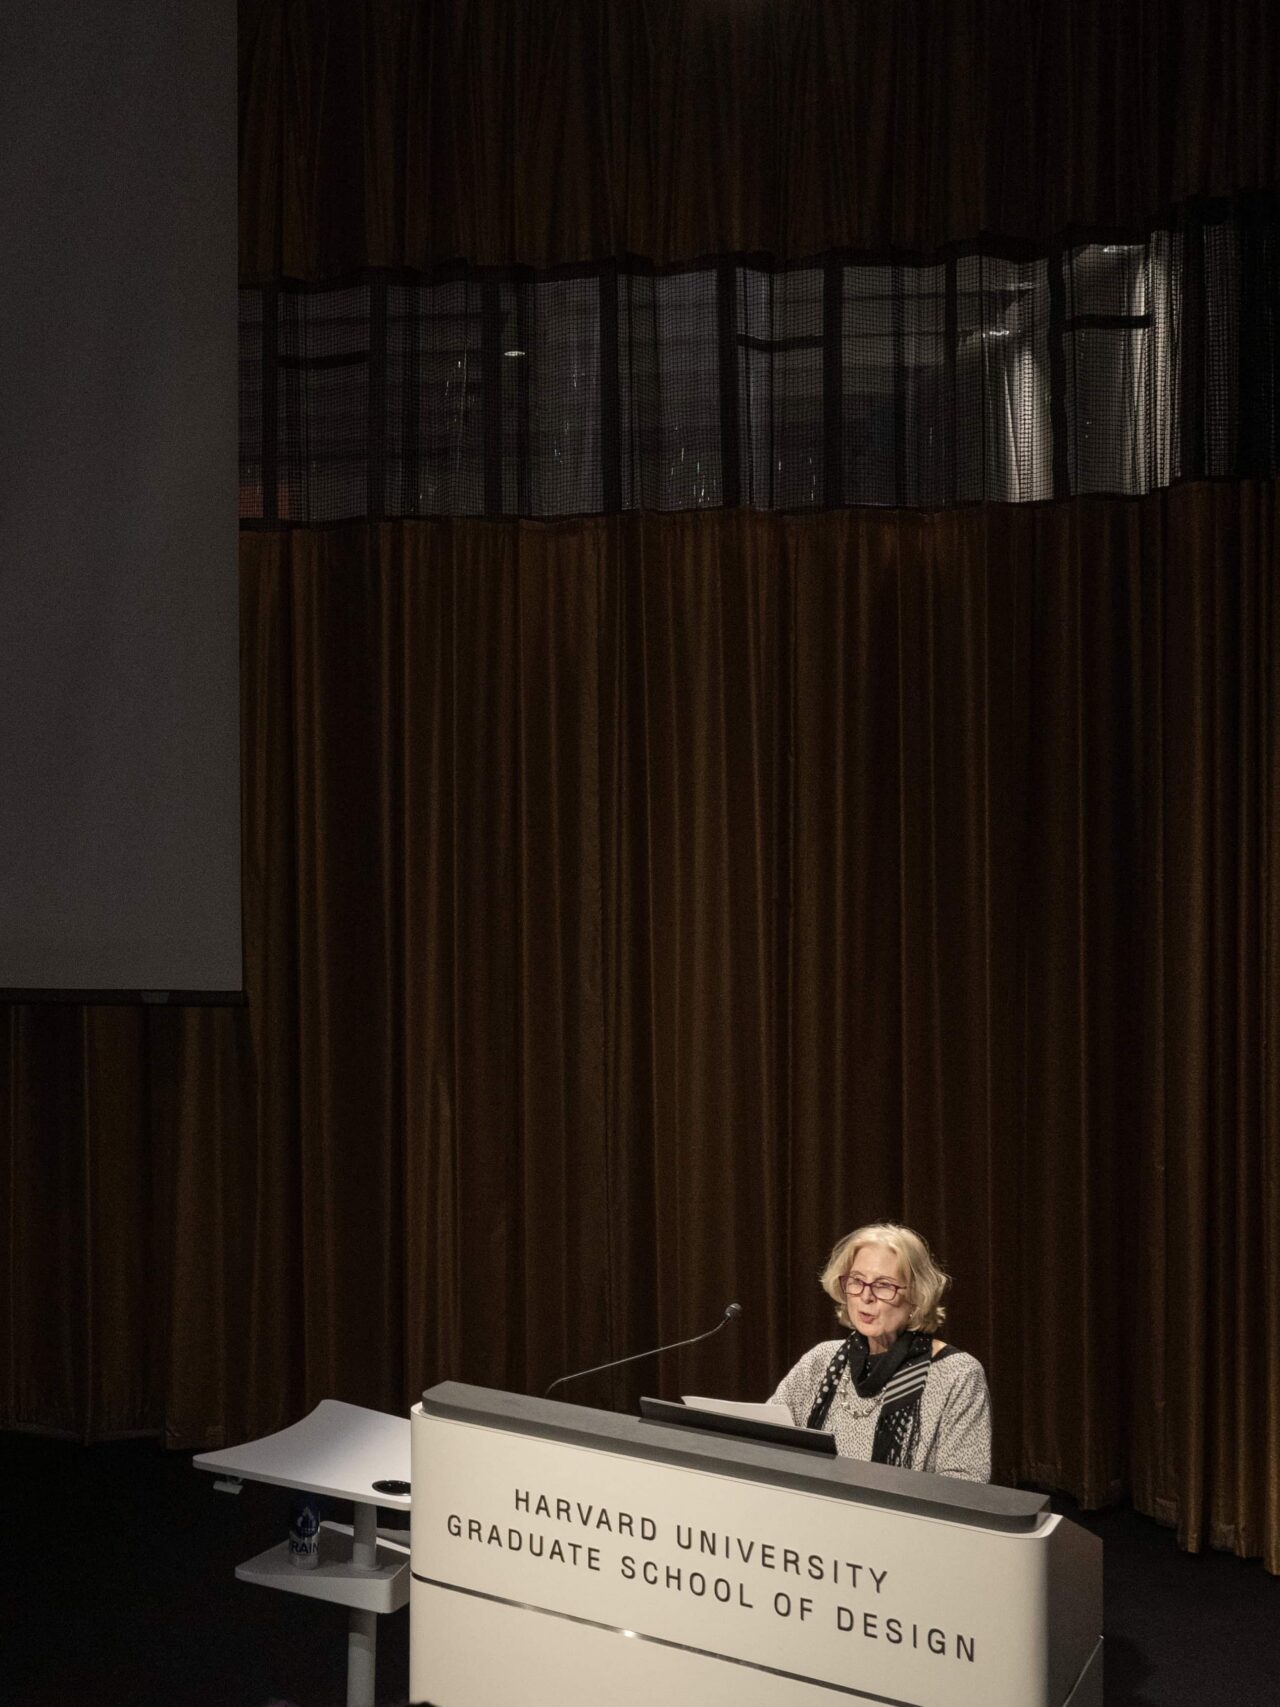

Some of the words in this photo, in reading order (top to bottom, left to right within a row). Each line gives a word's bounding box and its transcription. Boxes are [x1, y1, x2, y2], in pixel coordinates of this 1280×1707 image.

[447, 1514, 601, 1572] GRADUATE
[620, 1555, 755, 1609] SCHOOL
[773, 1592, 813, 1621] OF
[836, 1605, 975, 1663] DESIGN
[515, 1488, 658, 1542] HARVARD
[676, 1524, 888, 1594] UNIVERSITY
